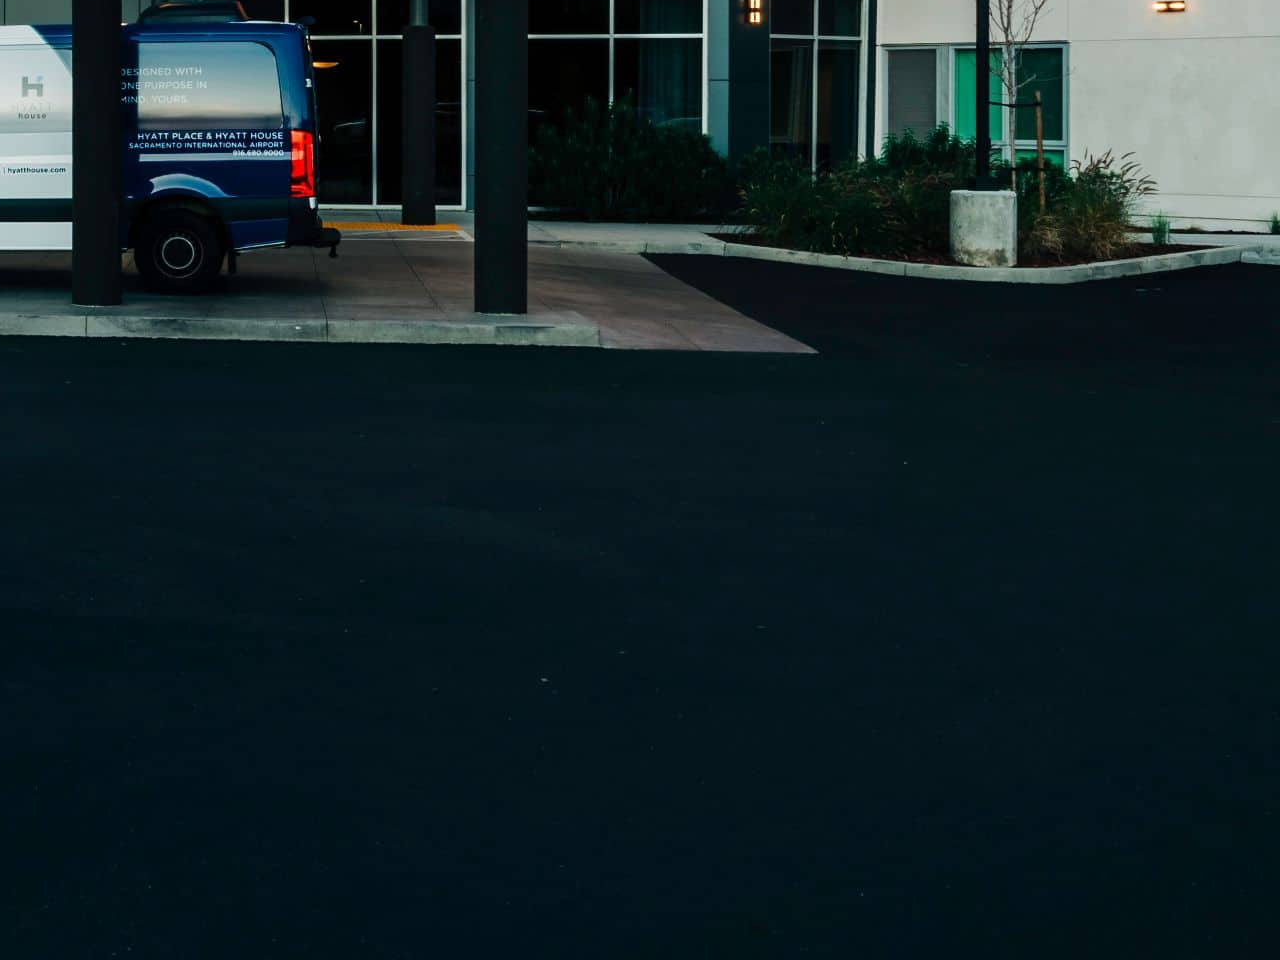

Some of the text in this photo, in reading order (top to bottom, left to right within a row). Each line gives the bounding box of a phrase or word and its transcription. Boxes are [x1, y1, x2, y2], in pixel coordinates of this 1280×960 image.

[175, 66, 202, 76] WITH
[144, 81, 193, 89] PURPOSE
[196, 80, 207, 89] IN
[138, 131, 283, 140] HYATT PLACE & HYATT HOUSE
